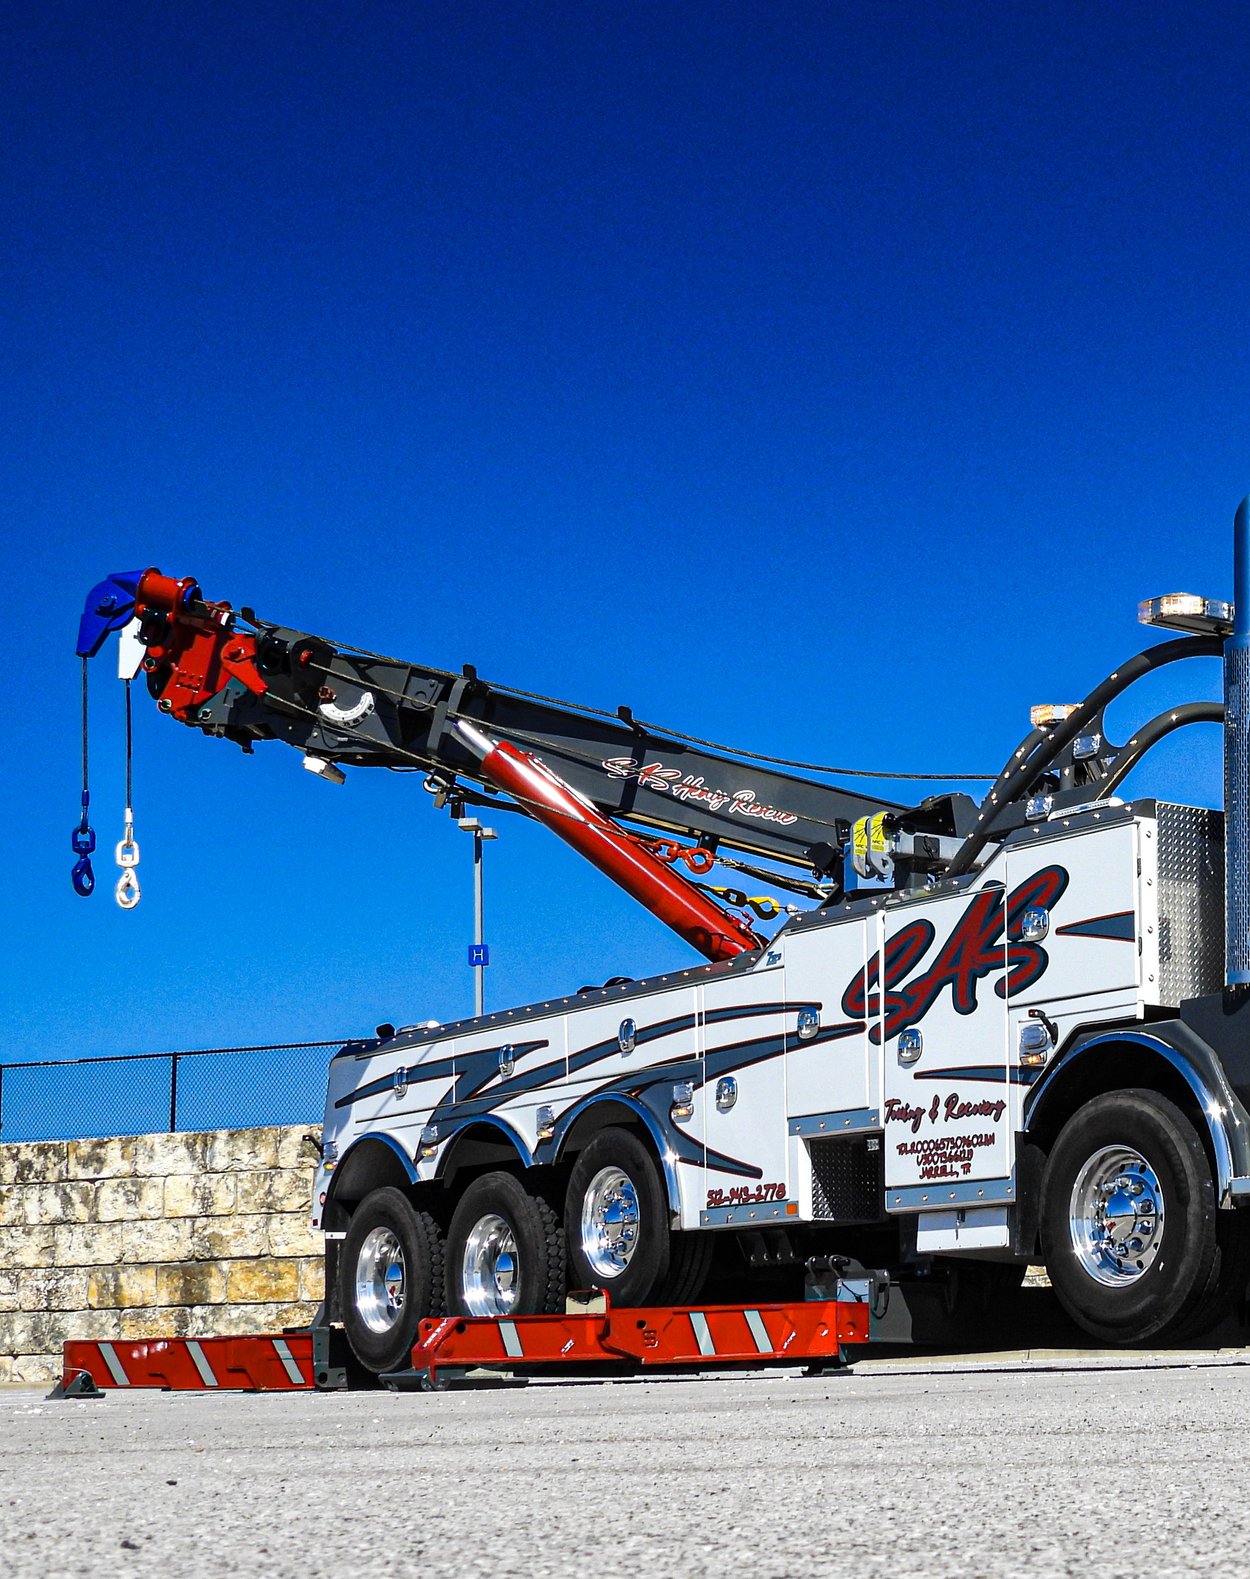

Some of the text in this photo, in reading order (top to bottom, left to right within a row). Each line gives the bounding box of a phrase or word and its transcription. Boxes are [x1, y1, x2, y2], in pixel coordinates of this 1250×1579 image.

[602, 757, 681, 790] SAS
[473, 948, 484, 961] H
[841, 864, 1070, 1046] SAS
[885, 1092, 1006, 1133] Towing & Recovery
